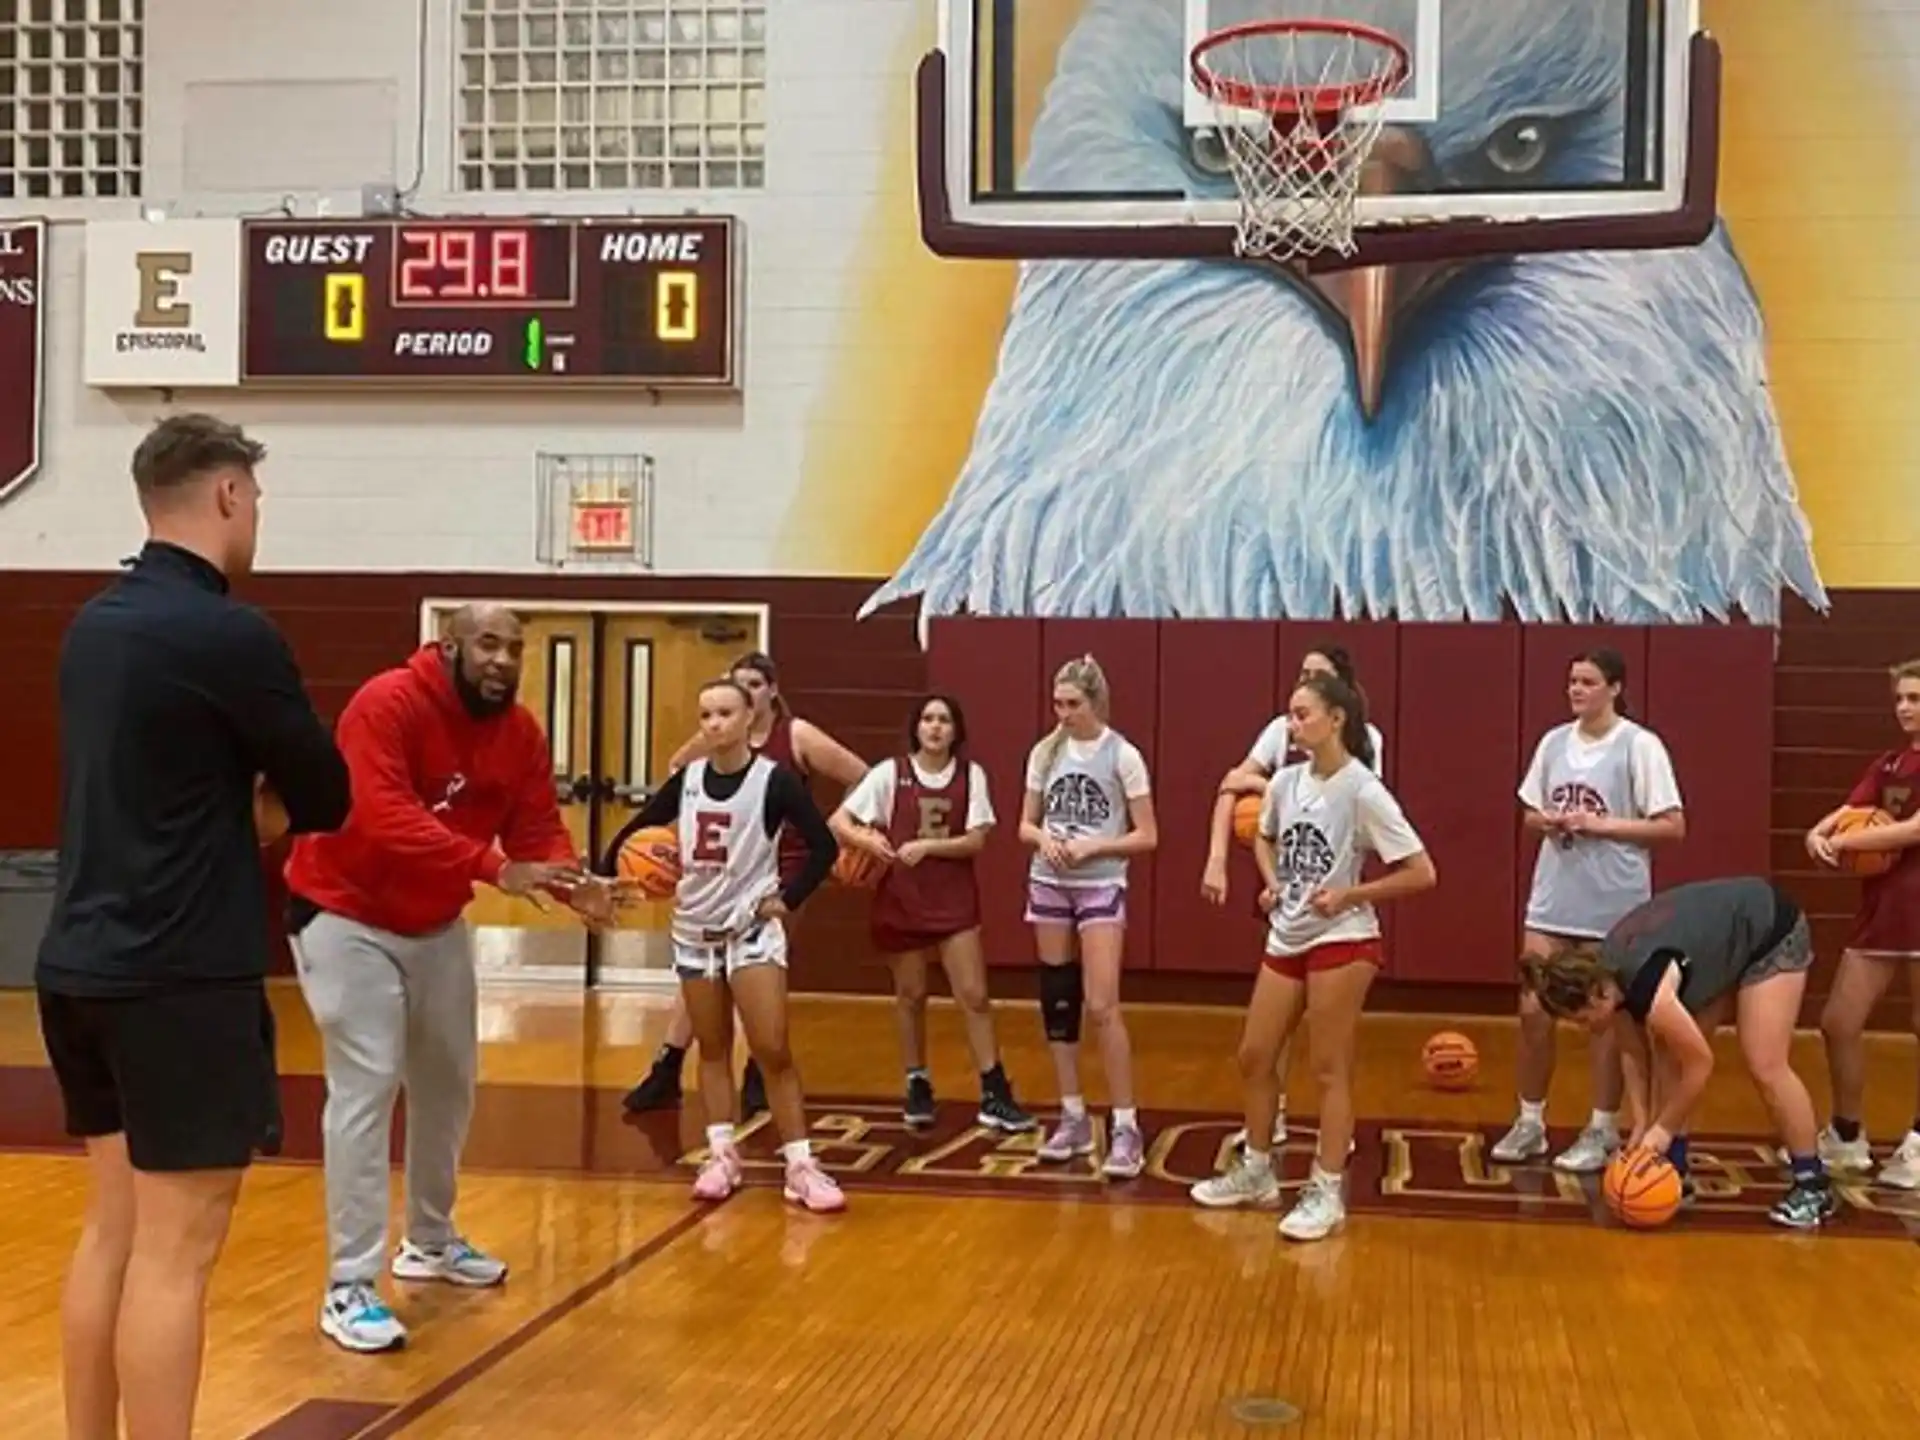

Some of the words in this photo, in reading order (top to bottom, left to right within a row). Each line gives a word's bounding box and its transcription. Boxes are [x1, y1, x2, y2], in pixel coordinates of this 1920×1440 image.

[265, 234, 374, 265] GUEST
[401, 230, 528, 297] 29.8
[600, 232, 704, 262] HOME
[134, 252, 192, 328] E
[324, 272, 364, 340] 0
[657, 271, 697, 340] 0
[115, 332, 207, 352] EPISCOPAL
[395, 332, 493, 356] PERIOD
[693, 811, 732, 863] E
[917, 797, 953, 839] E
